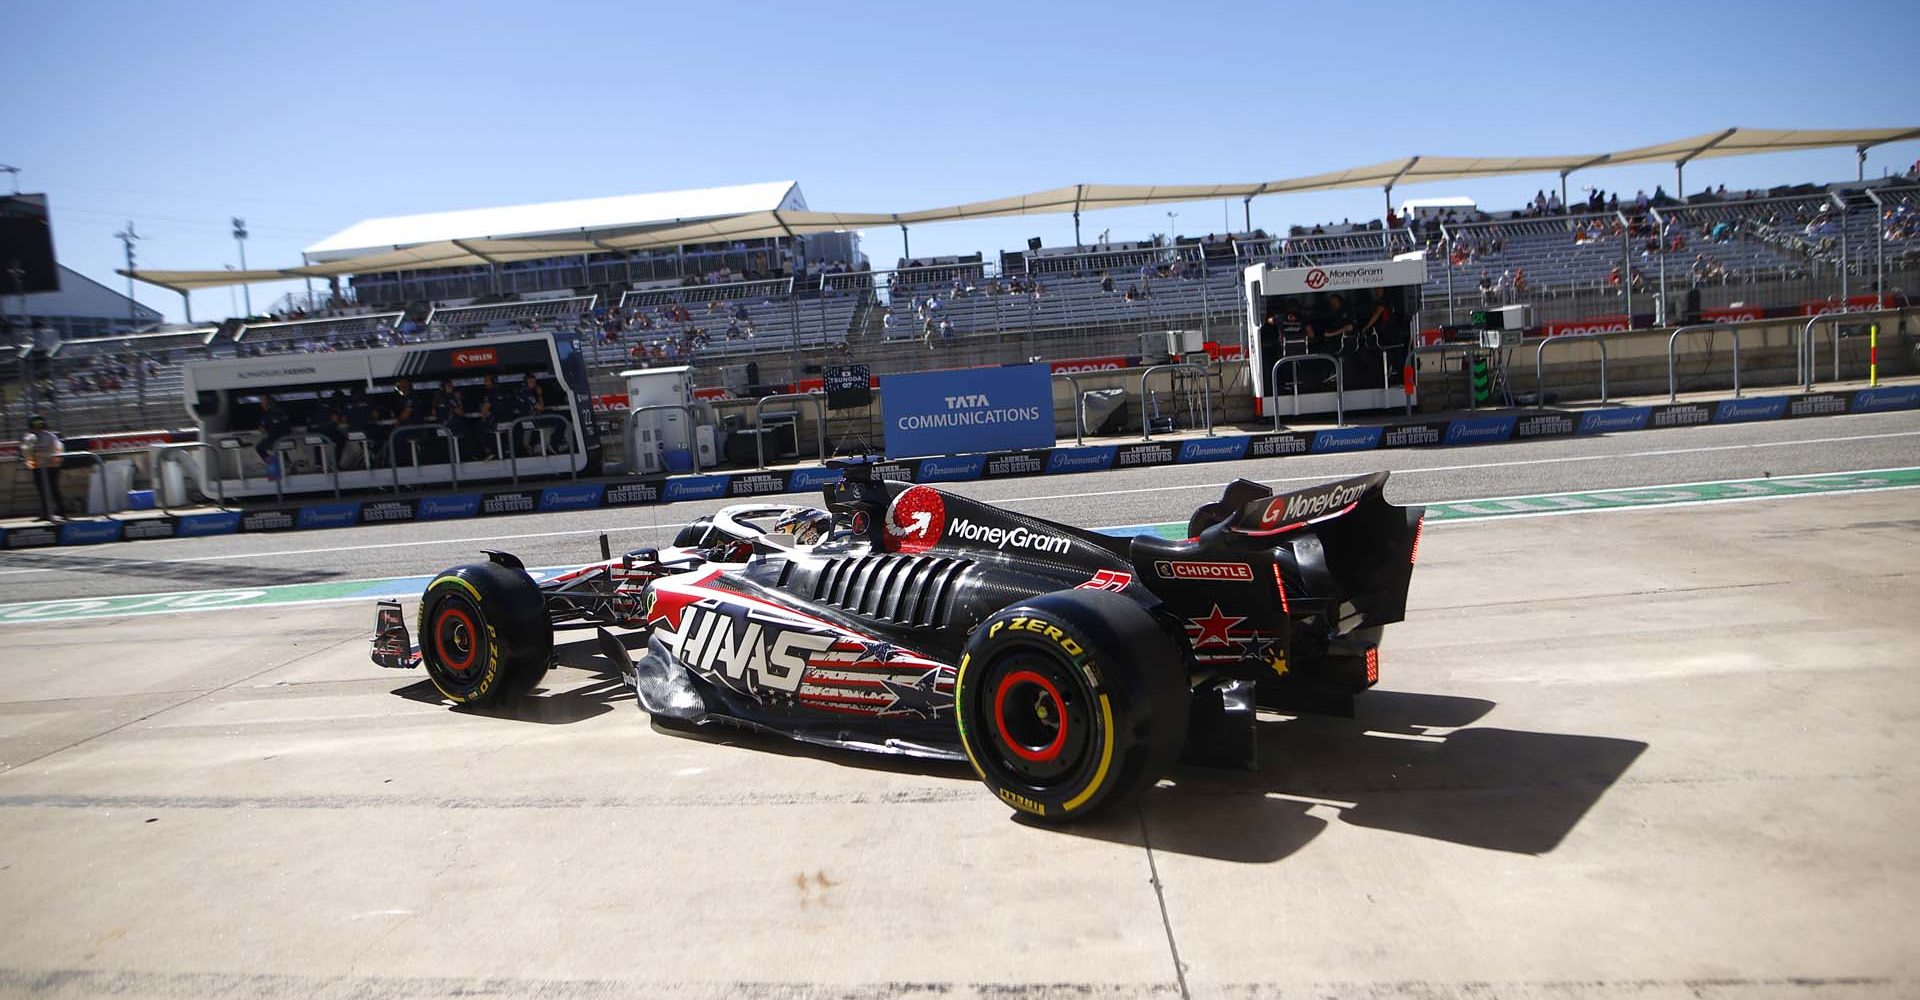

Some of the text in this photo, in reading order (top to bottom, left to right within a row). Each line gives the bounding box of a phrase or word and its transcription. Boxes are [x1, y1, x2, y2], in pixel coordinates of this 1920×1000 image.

[1329, 268, 1383, 278] MoneyGram
[468, 353, 493, 362] ORLEN
[1056, 364, 1118, 375] enovo
[945, 394, 989, 409] TATA
[899, 407, 1040, 430] COMMUNICATIONS
[1253, 441, 1306, 454] BASS REEVES
[1319, 434, 1376, 449] Paramount+
[1120, 451, 1172, 464] BASS REEVES
[1184, 443, 1242, 458] Paramount+
[990, 461, 1040, 474] BASS REEVES
[1053, 453, 1111, 467] Paramount+
[922, 461, 979, 477] Paramount+
[733, 480, 783, 493] BASS REEVES
[1283, 483, 1366, 521] MoneyGram
[948, 517, 1071, 554] MoneyGram
[1176, 564, 1249, 578] CHIPOTLE
[989, 617, 1084, 657] P ZERO
[654, 605, 839, 692] HAAS
[479, 624, 500, 695] P ZERO
